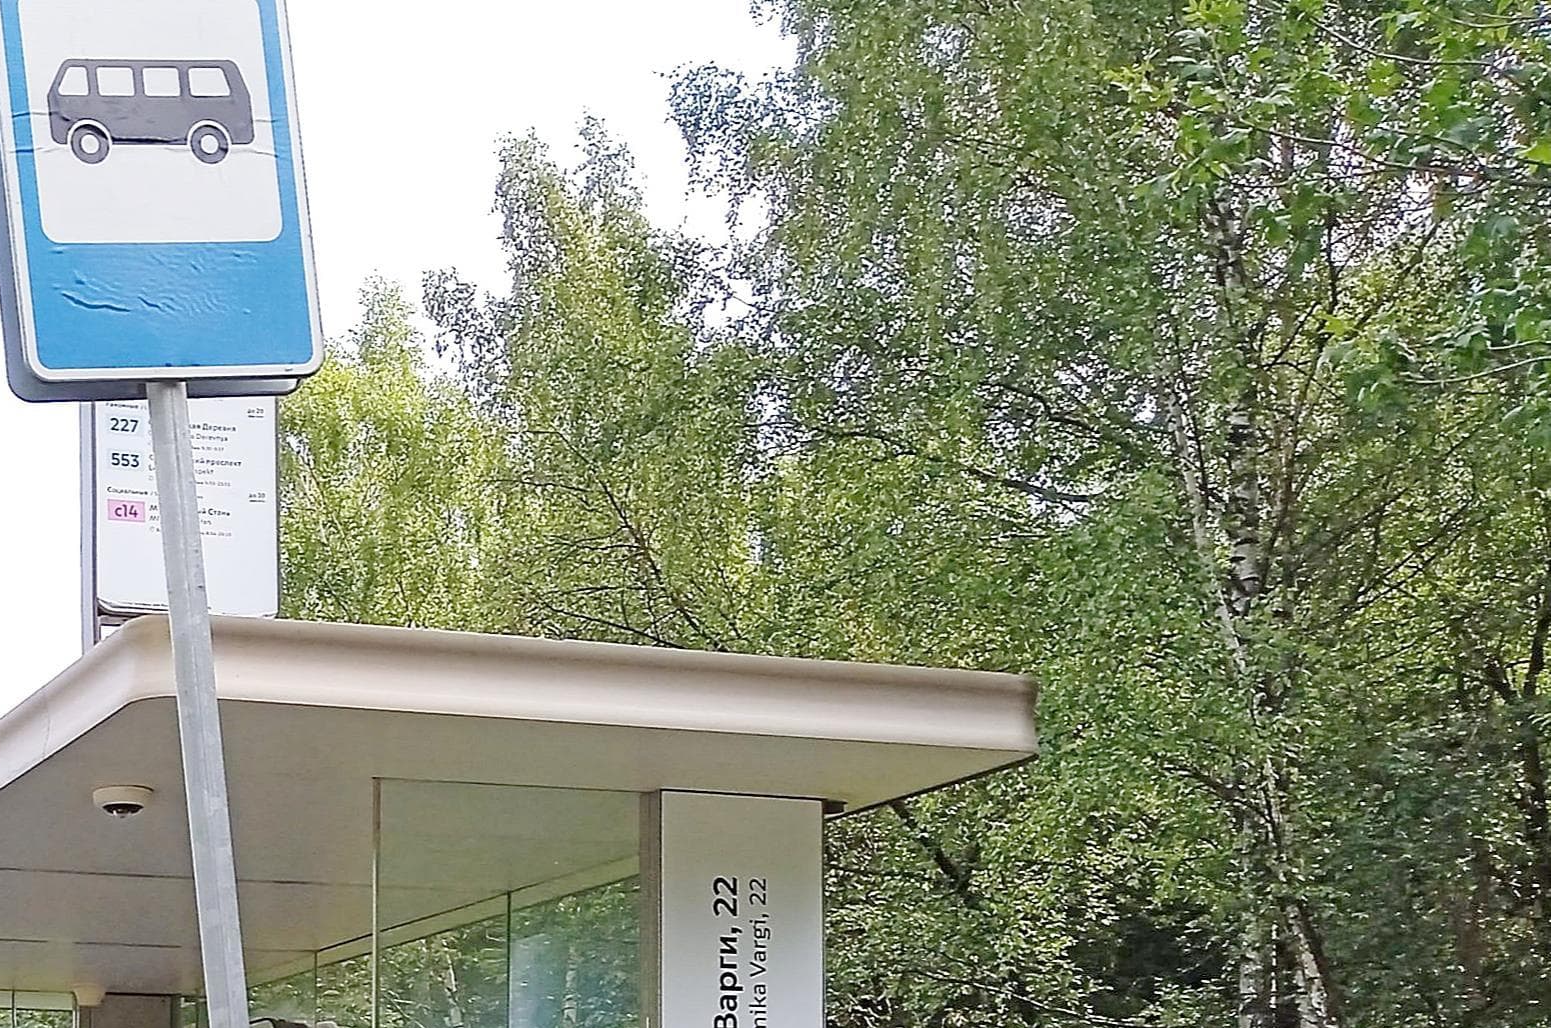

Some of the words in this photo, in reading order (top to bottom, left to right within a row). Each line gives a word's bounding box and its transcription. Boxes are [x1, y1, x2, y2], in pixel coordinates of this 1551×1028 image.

[109, 417, 139, 433] 227
[111, 453, 140, 468] 553
[712, 877, 738, 917] 22
[749, 878, 767, 905] 22
[749, 913, 771, 977] Vargi,
